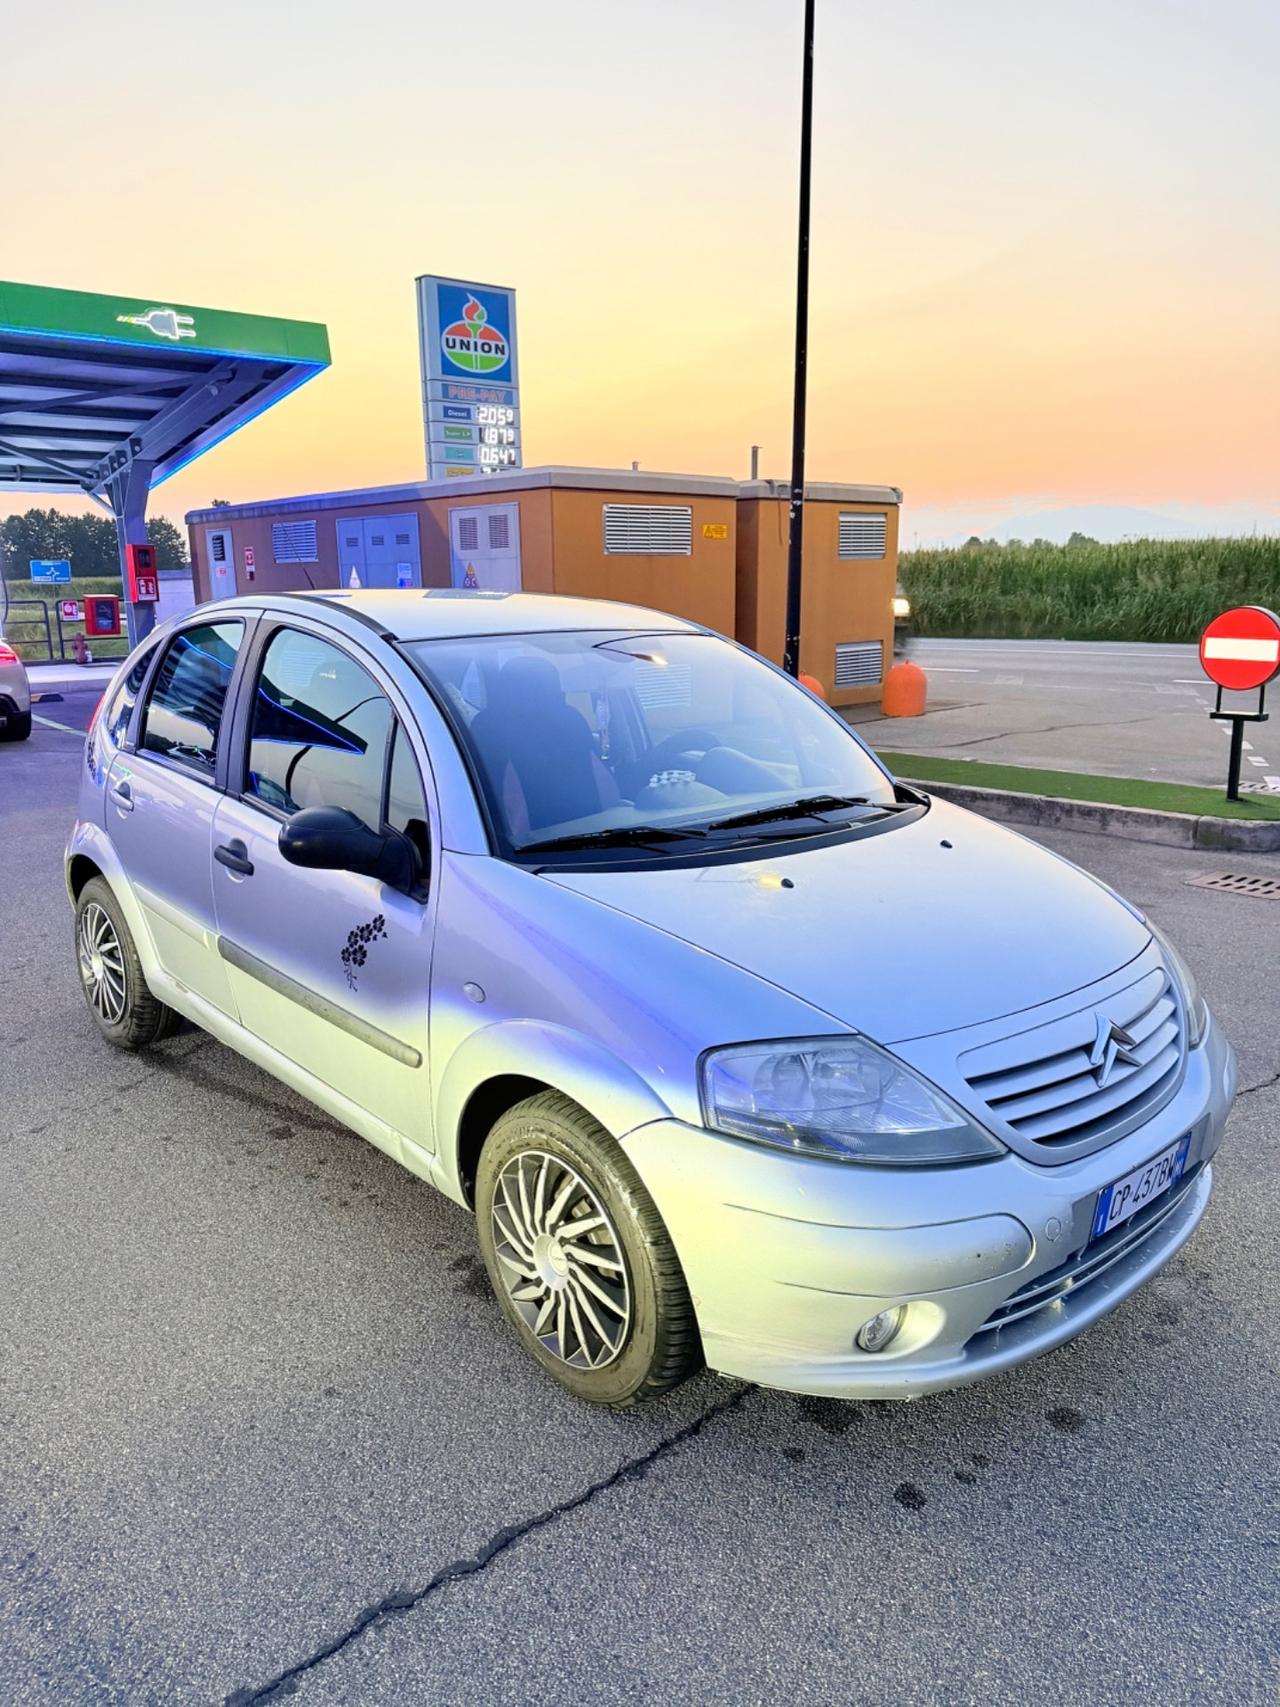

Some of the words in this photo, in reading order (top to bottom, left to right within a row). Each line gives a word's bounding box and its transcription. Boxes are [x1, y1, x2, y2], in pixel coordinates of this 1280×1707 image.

[445, 337, 506, 355] UNION
[447, 409, 468, 417] Diesel
[1109, 1184, 1131, 1220] CP
